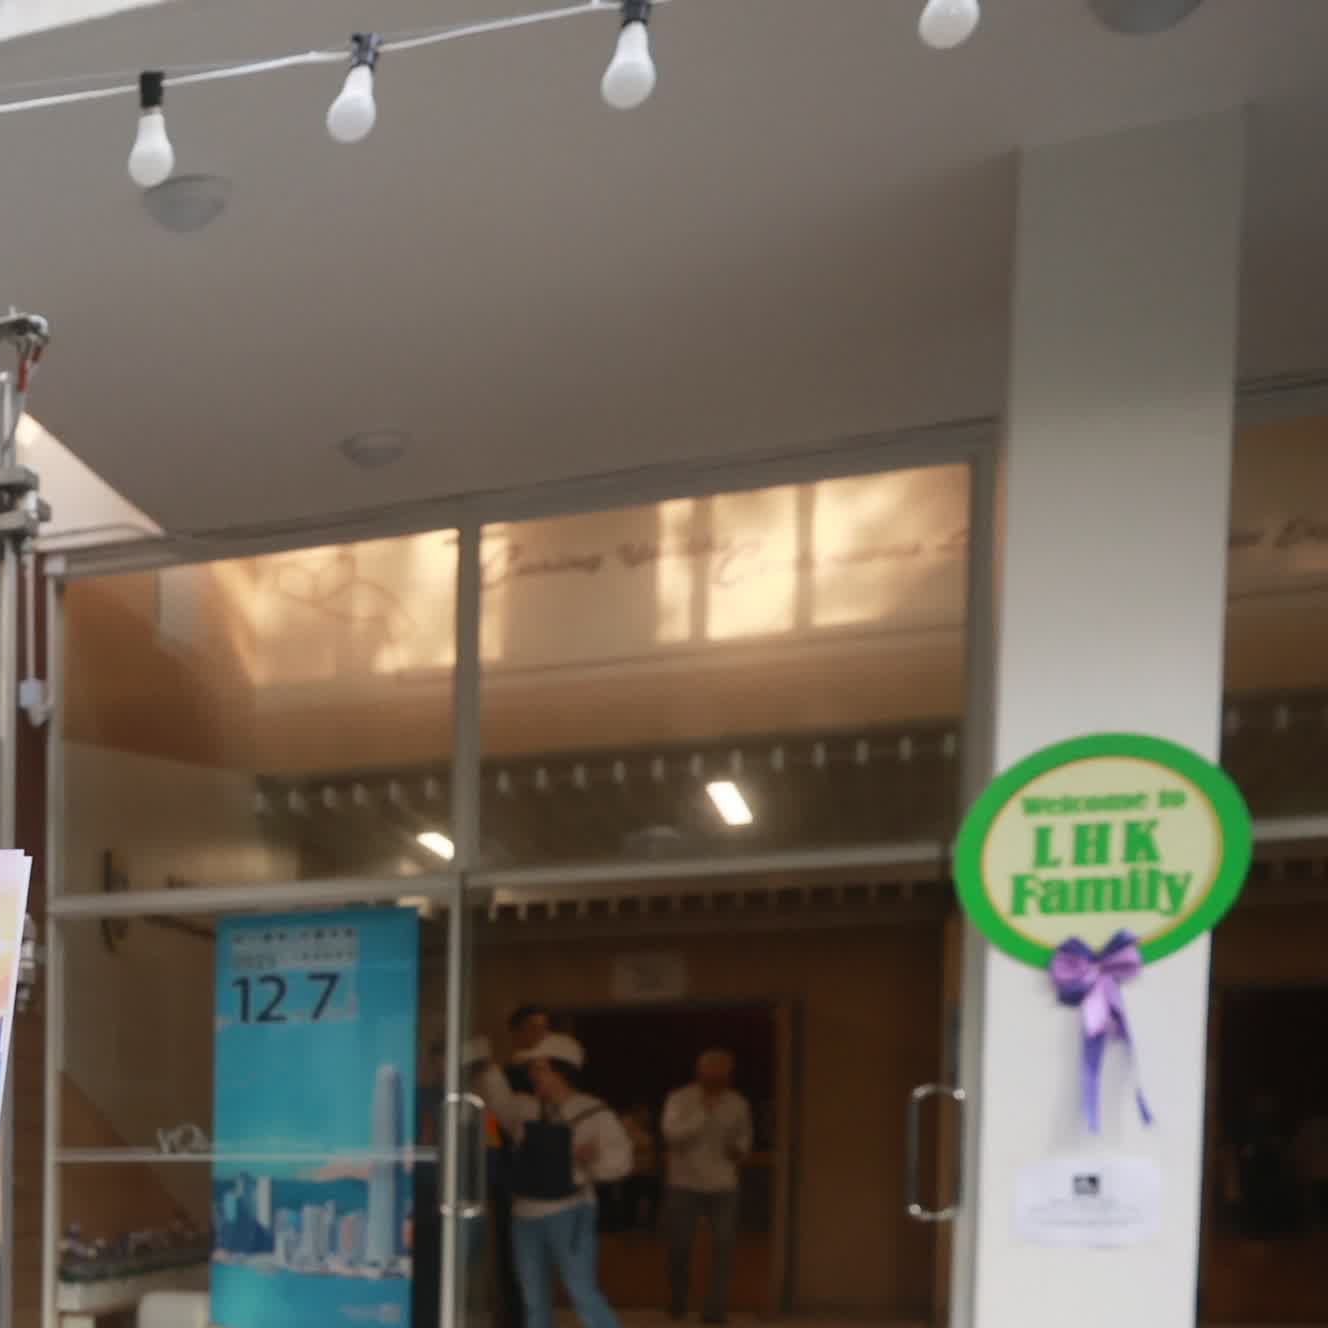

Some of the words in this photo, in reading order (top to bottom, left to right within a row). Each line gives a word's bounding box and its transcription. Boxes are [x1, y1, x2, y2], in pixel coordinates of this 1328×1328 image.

[1024, 793, 1147, 817] Welcome
[1158, 789, 1186, 810] to
[1035, 820, 1160, 868] LHK
[1012, 869, 1192, 917] Family
[232, 975, 288, 1025] 12
[306, 972, 341, 1021] 7
